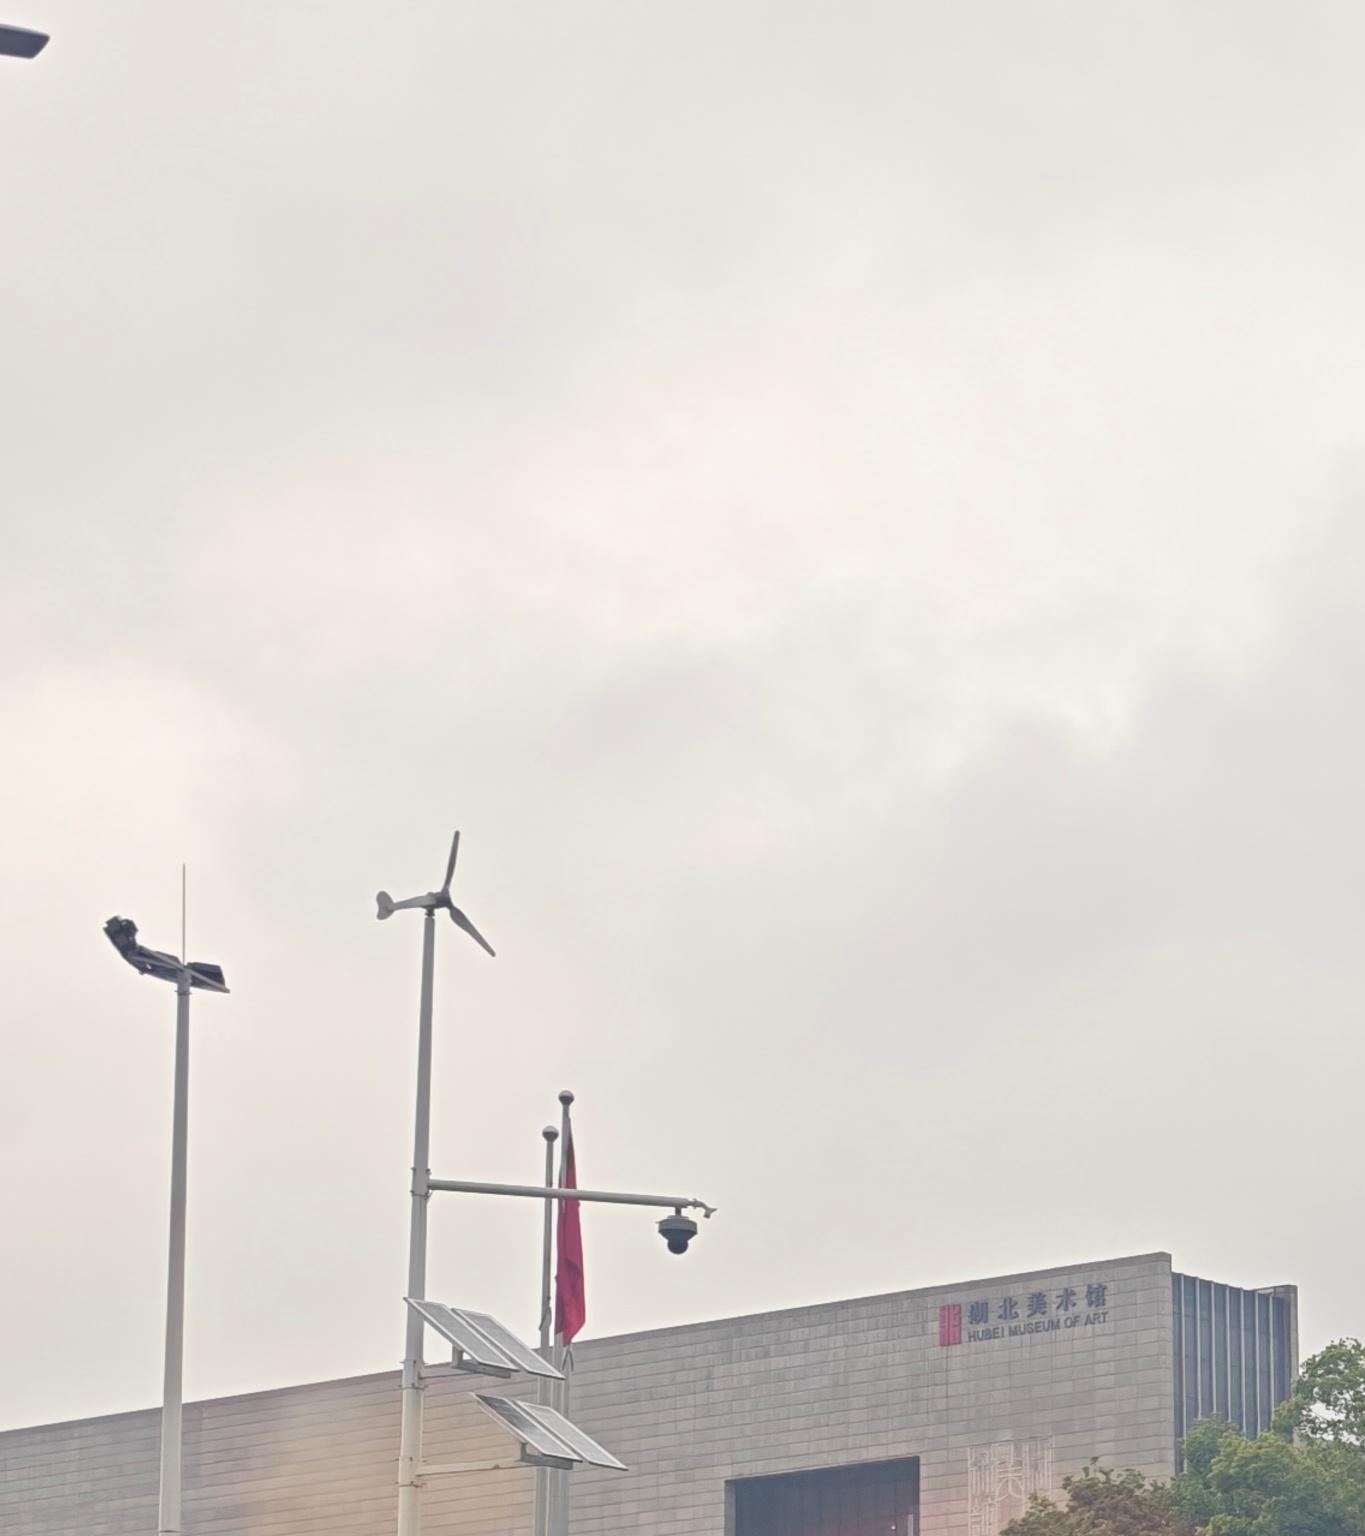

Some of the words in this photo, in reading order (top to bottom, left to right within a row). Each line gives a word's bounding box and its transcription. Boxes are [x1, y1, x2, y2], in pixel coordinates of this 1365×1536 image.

[969, 1283, 1107, 1325] 湖北美术馆
[968, 1327, 1005, 1343] HUBEI
[1008, 1318, 1061, 1337] MUSEUM
[1064, 1315, 1081, 1329] OF
[1084, 1310, 1109, 1327] ART
